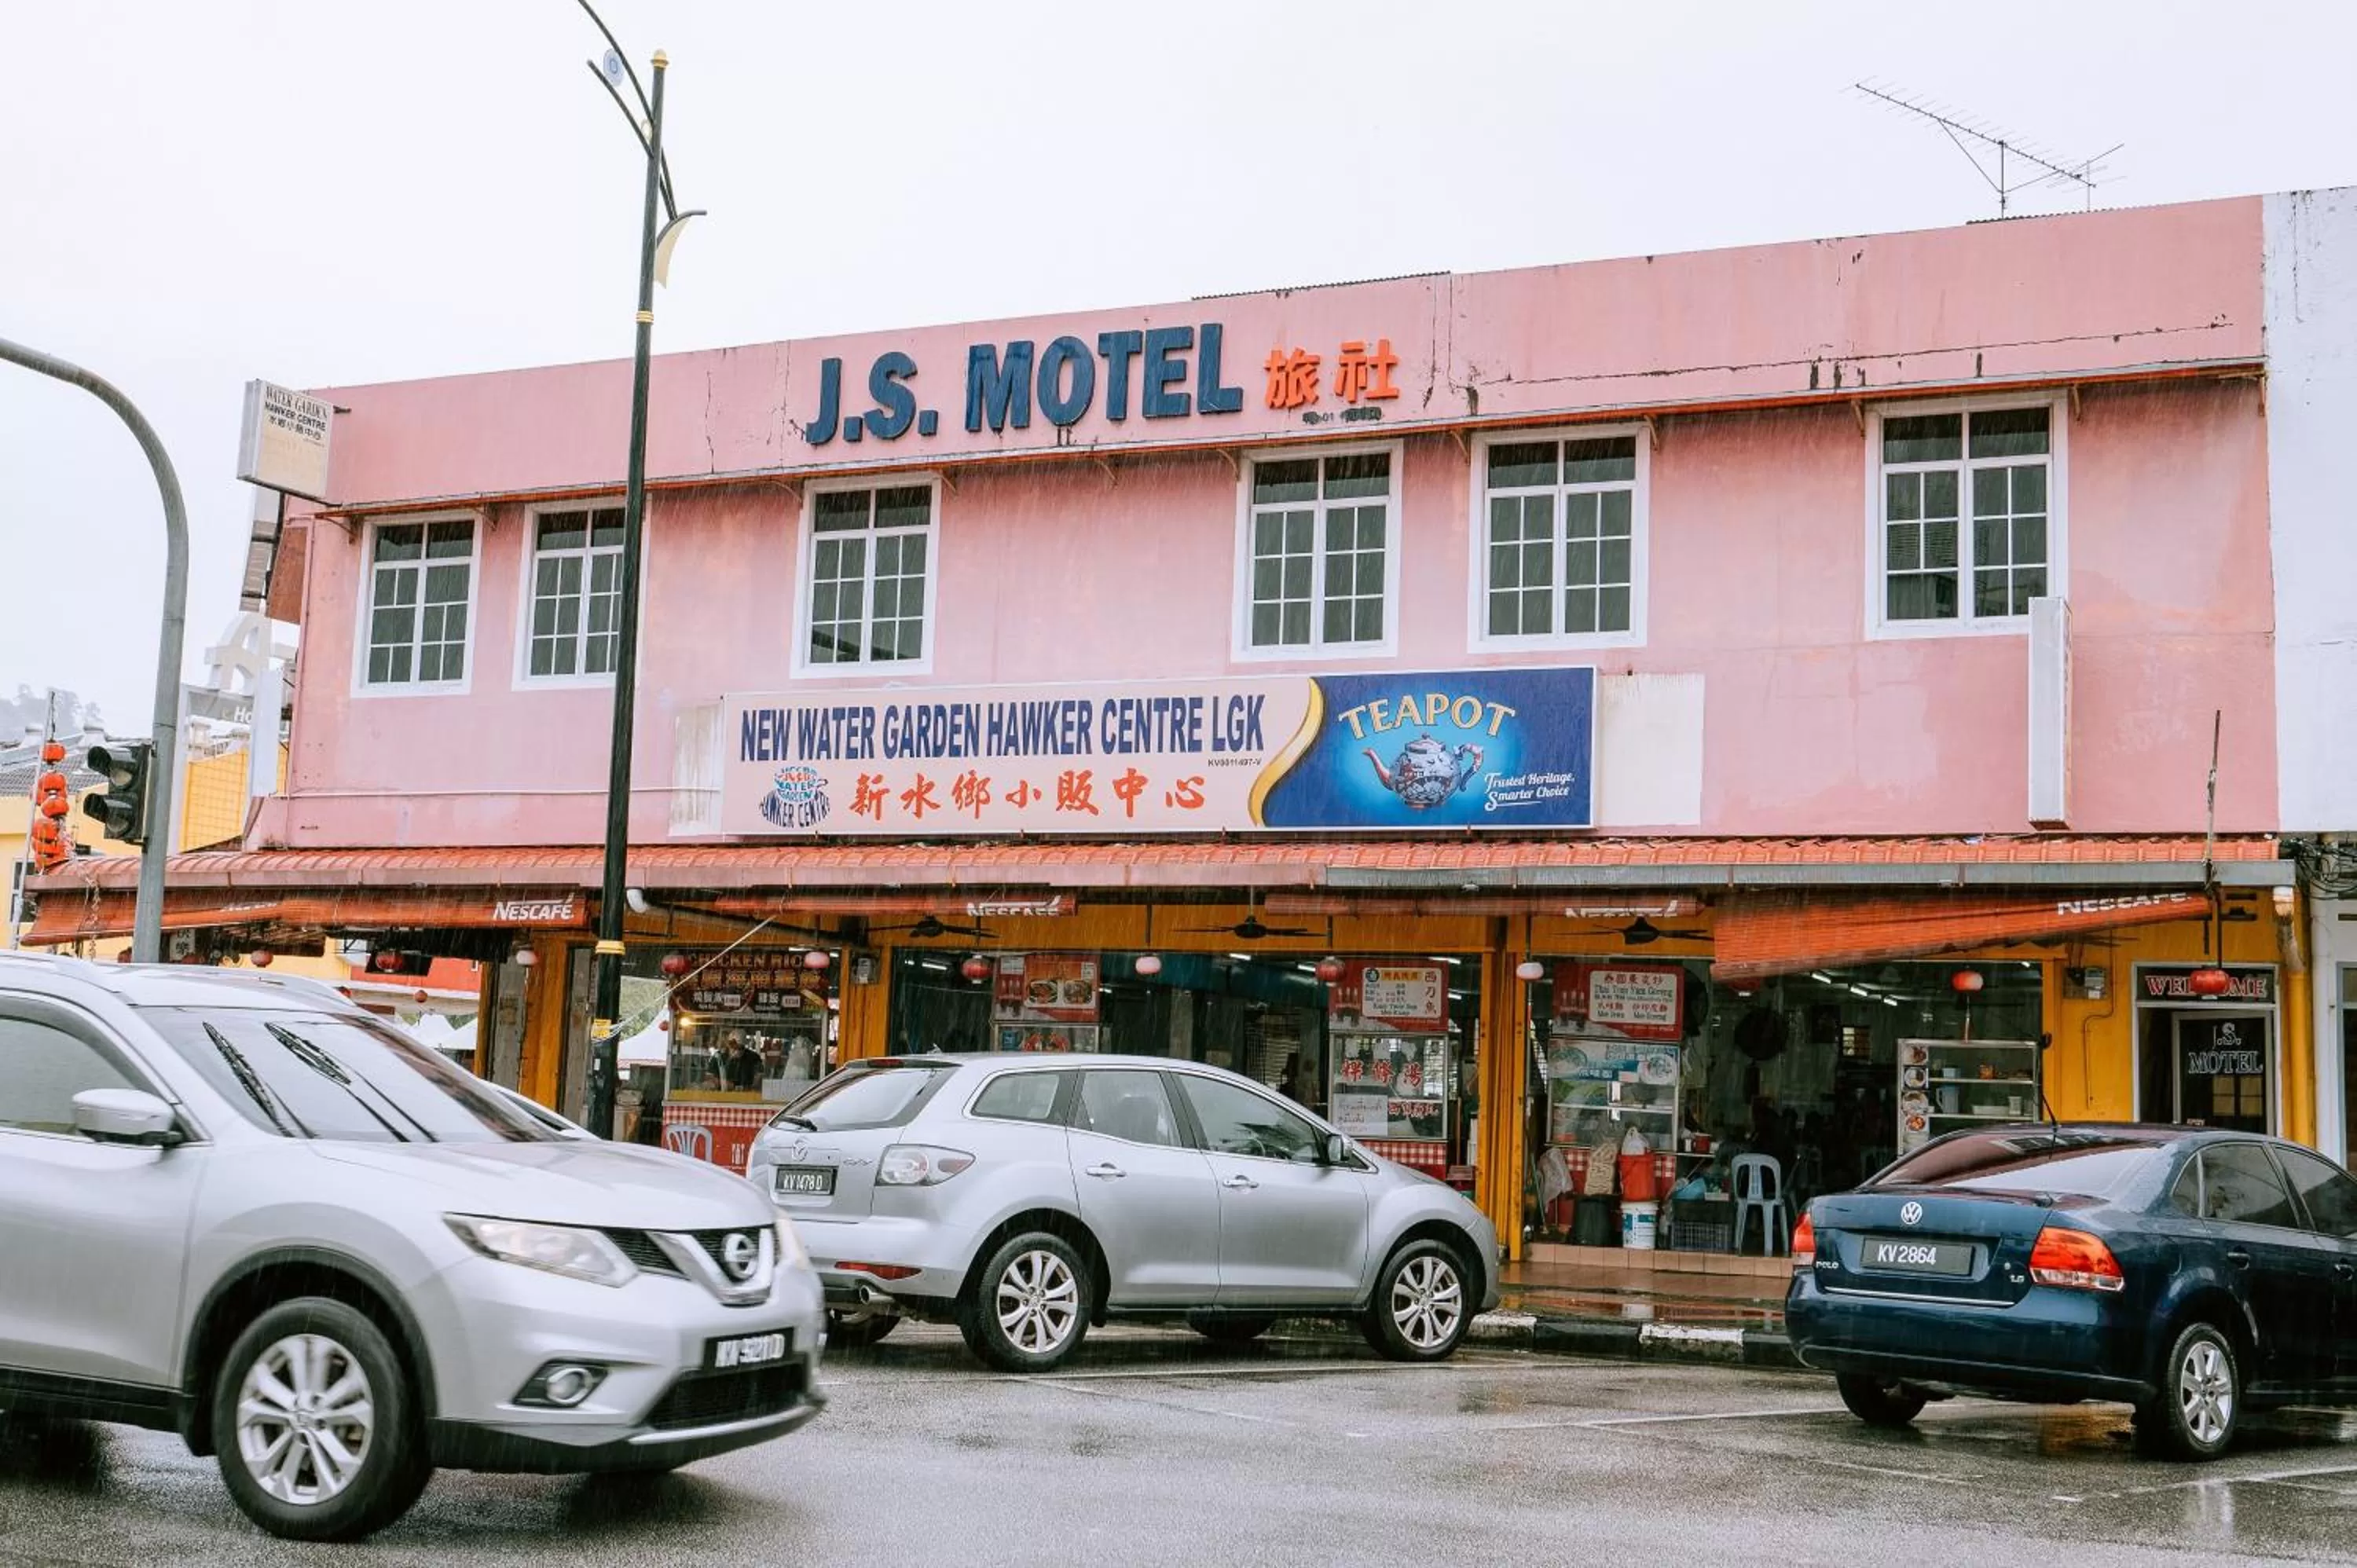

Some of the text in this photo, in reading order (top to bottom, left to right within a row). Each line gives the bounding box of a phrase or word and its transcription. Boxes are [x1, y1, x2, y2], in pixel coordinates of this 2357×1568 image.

[806, 323, 1243, 445] J.S. MOTEL
[1264, 339, 1399, 408] 旅社
[297, 415, 326, 431] CENTRE
[1337, 692, 1516, 739] TEAPOT
[741, 694, 1266, 762] NEW WATER GARDEN HAWKER CENTRE LGK
[1484, 771, 1526, 793] Trusted
[1484, 786, 1570, 811] Smarter Choice
[691, 953, 803, 969] CHICKEN RIC
[2145, 975, 2267, 998] WELME
[2188, 1050, 2264, 1074] MOTEL
[1878, 1244, 1937, 1266] KV2864
